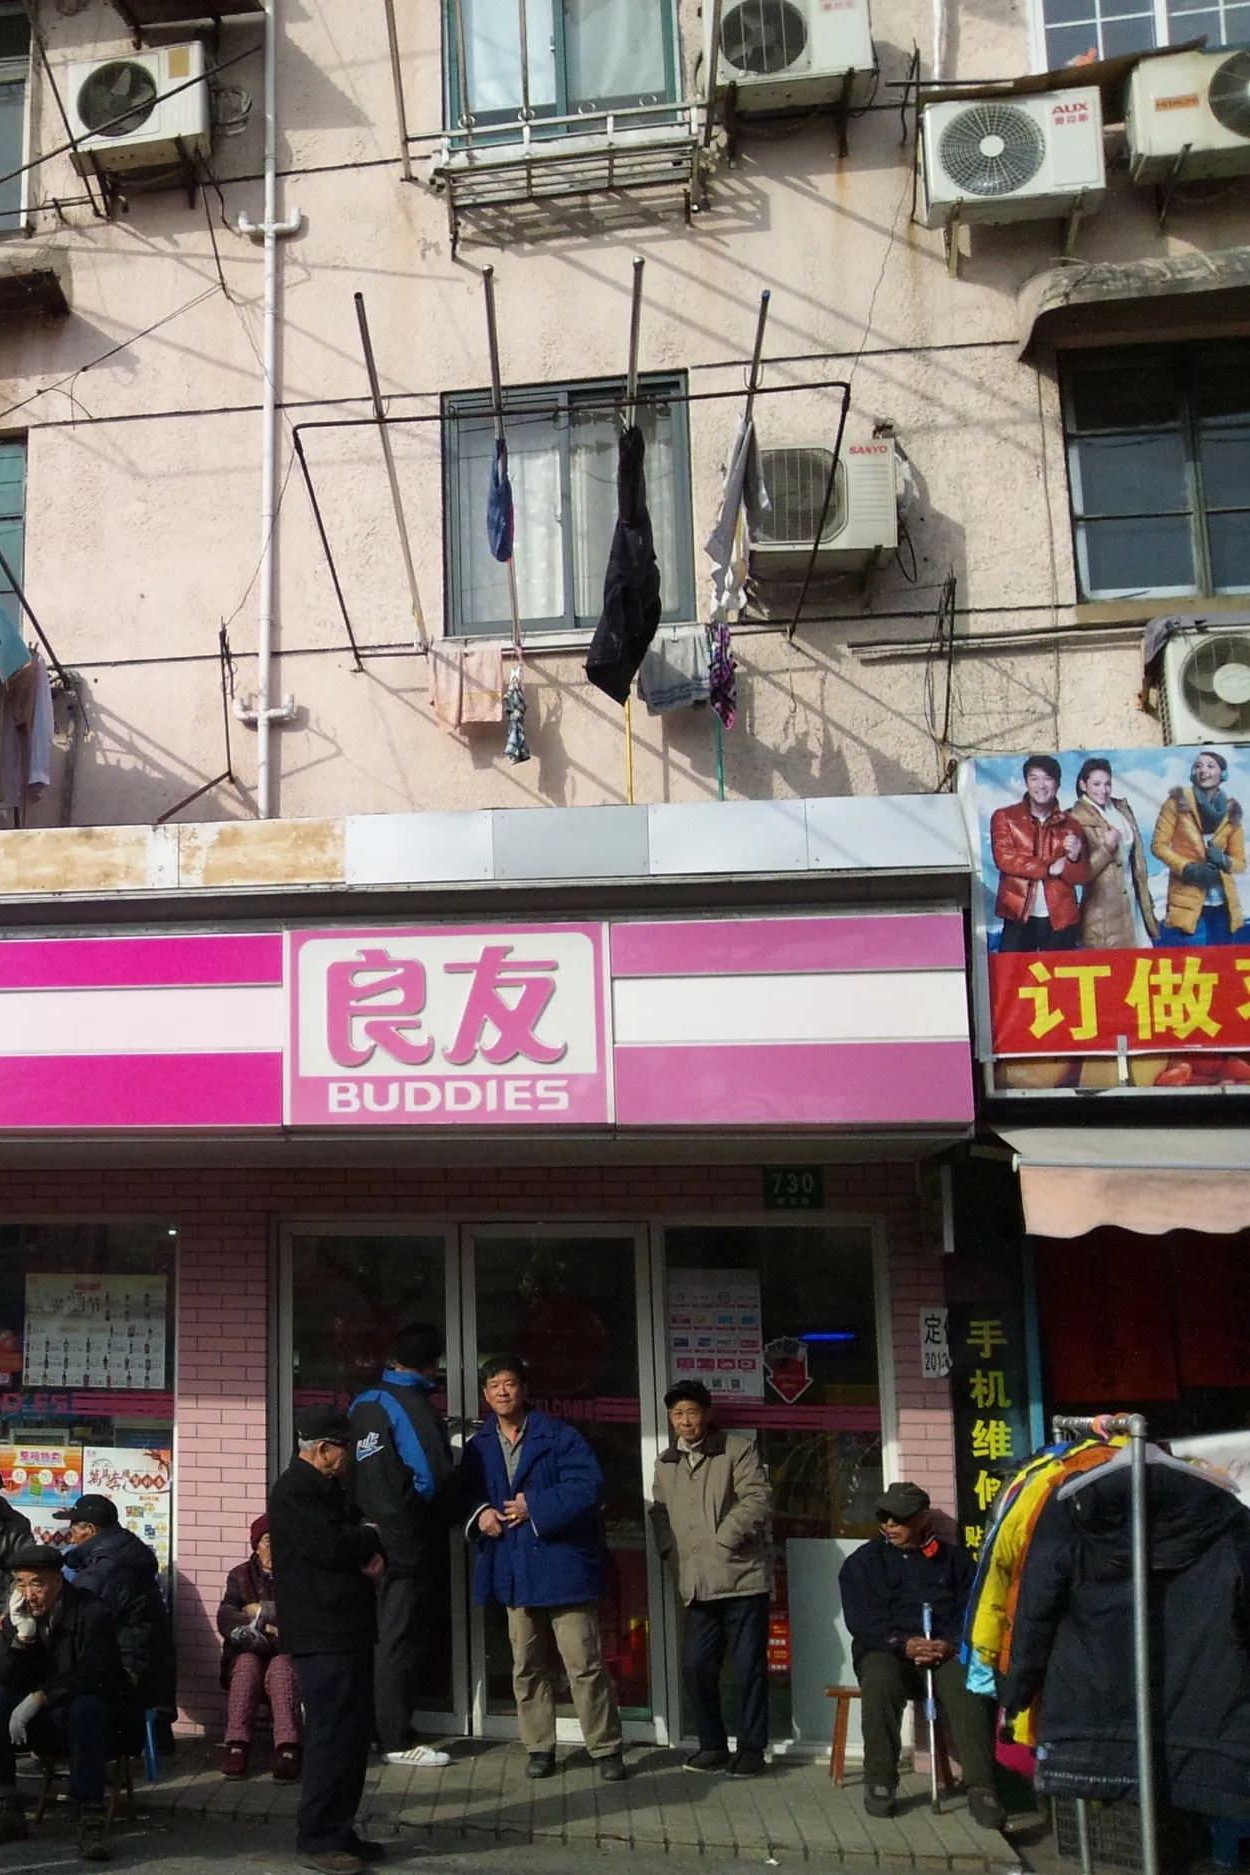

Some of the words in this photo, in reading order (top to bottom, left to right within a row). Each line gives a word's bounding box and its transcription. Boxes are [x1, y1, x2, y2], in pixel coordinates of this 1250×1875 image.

[1052, 102, 1088, 115] AUX
[849, 445, 888, 455] SANYO
[326, 945, 568, 1068] 良友
[1018, 955, 1250, 1040] 订做
[328, 1079, 570, 1114] BUDDIES
[771, 1171, 815, 1195] 730
